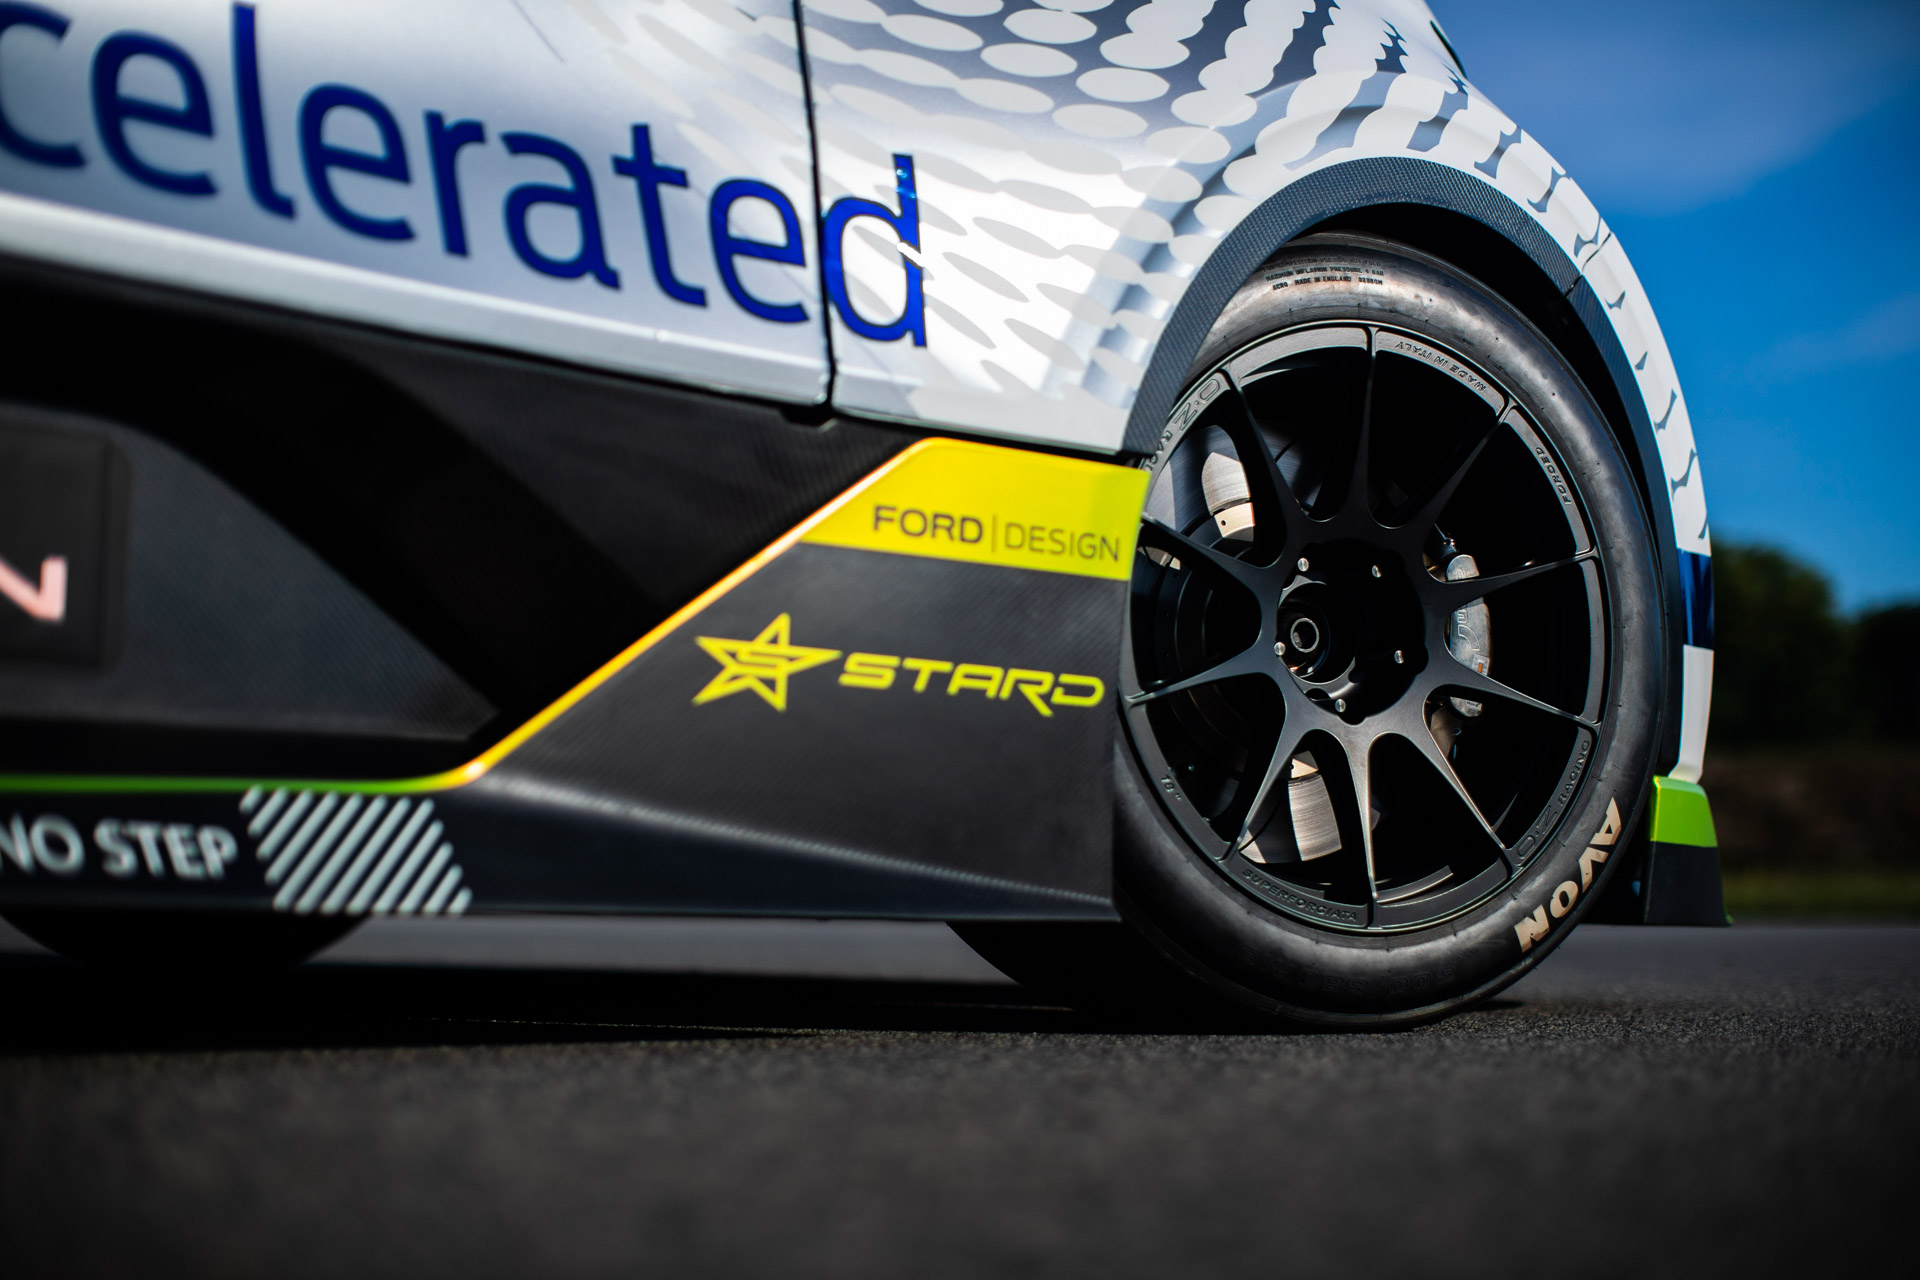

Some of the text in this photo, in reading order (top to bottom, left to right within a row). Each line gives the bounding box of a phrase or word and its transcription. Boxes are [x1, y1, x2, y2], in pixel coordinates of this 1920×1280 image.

[0, 2, 928, 347] celerated
[1265, 271, 1294, 282] MAXIMUM
[1295, 266, 1328, 275] INFLATION
[1330, 266, 1362, 274] PRESSURE
[1372, 268, 1384, 277] BAR
[1294, 277, 1312, 286] MADE
[1323, 275, 1352, 283] ENGLAND
[1395, 341, 1487, 393] MADE IN ITALY
[873, 504, 1119, 562] FORD DESIGN
[838, 651, 1105, 717] STARD
[1558, 740, 1589, 807] RACING
[0, 813, 238, 880] NO STEP
[1514, 796, 1622, 953] AVON
[1242, 868, 1357, 922] SUPERFORGIATA
